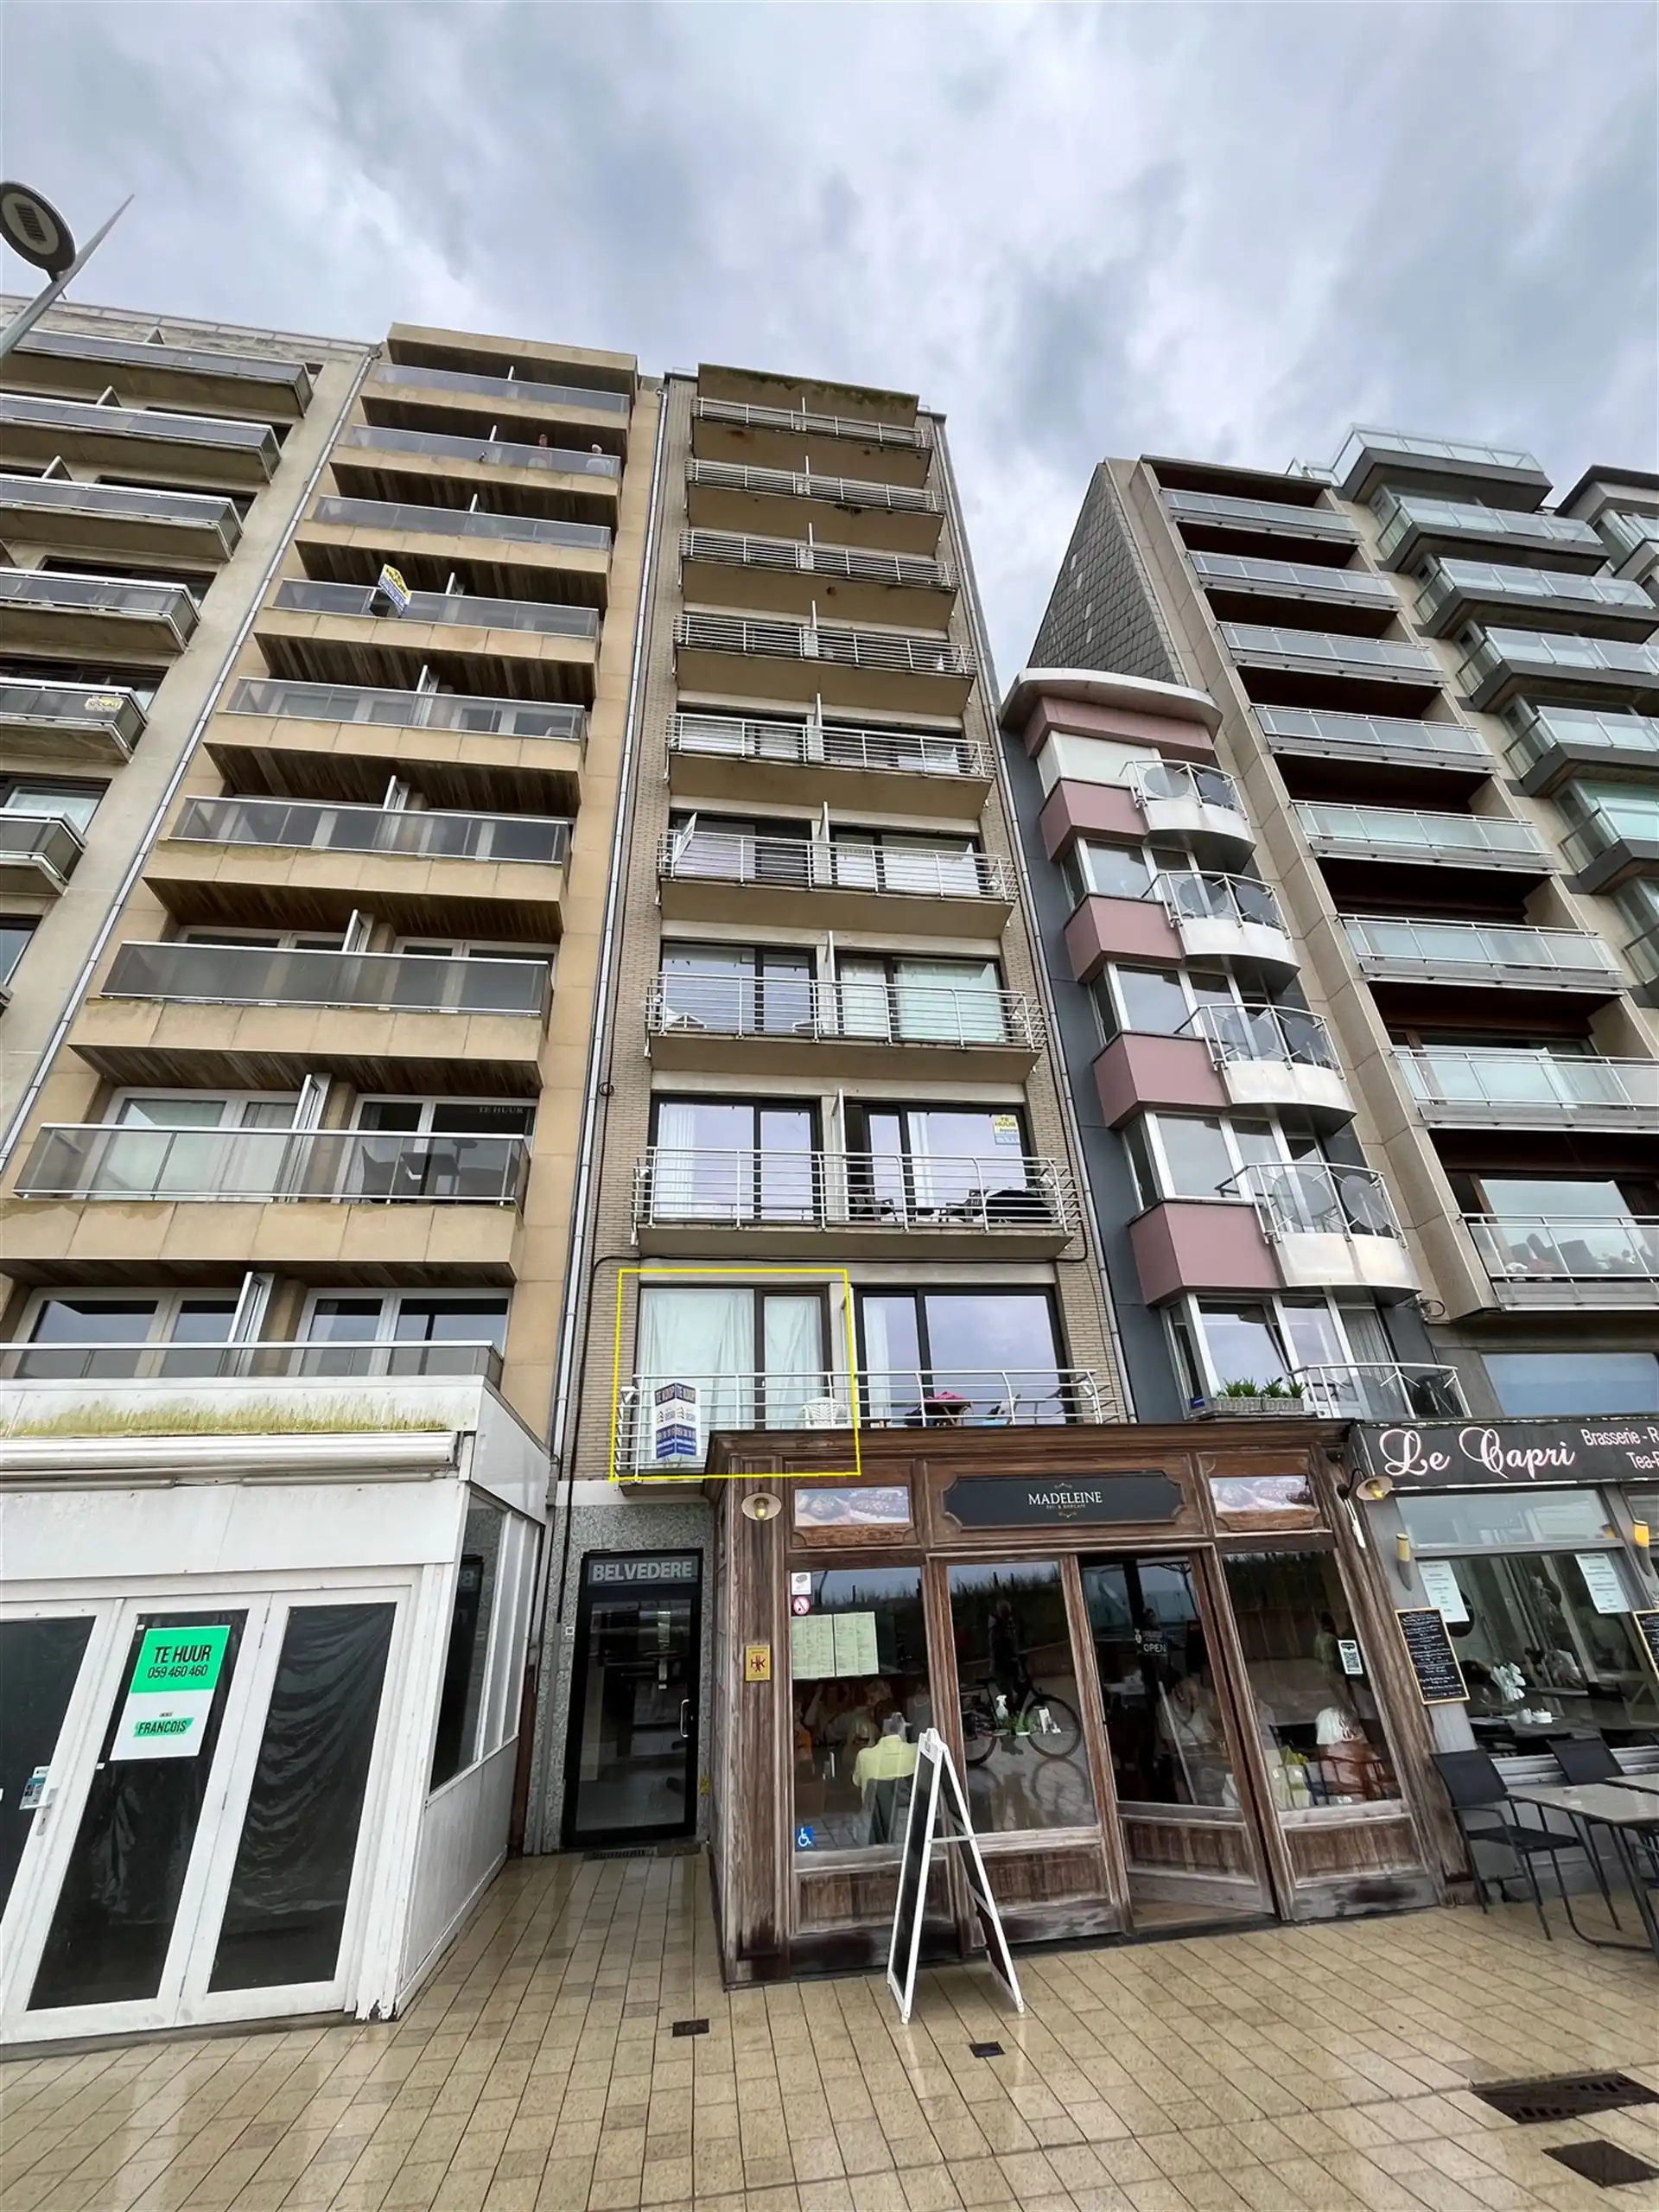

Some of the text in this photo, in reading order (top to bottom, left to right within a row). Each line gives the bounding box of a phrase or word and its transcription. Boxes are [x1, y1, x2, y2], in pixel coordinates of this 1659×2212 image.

[1580, 1427, 1641, 1446] Brasserie
[1379, 1427, 1576, 1479] Le Capri
[1027, 1491, 1103, 1505] MADELEINE
[593, 1561, 692, 1581] BELVEDERE
[154, 1644, 212, 1663] TE HUUR
[1143, 1643, 1166, 1653] OPEN
[148, 1664, 208, 1679] 059 460 460
[137, 1720, 188, 1735] FRANCOIS
